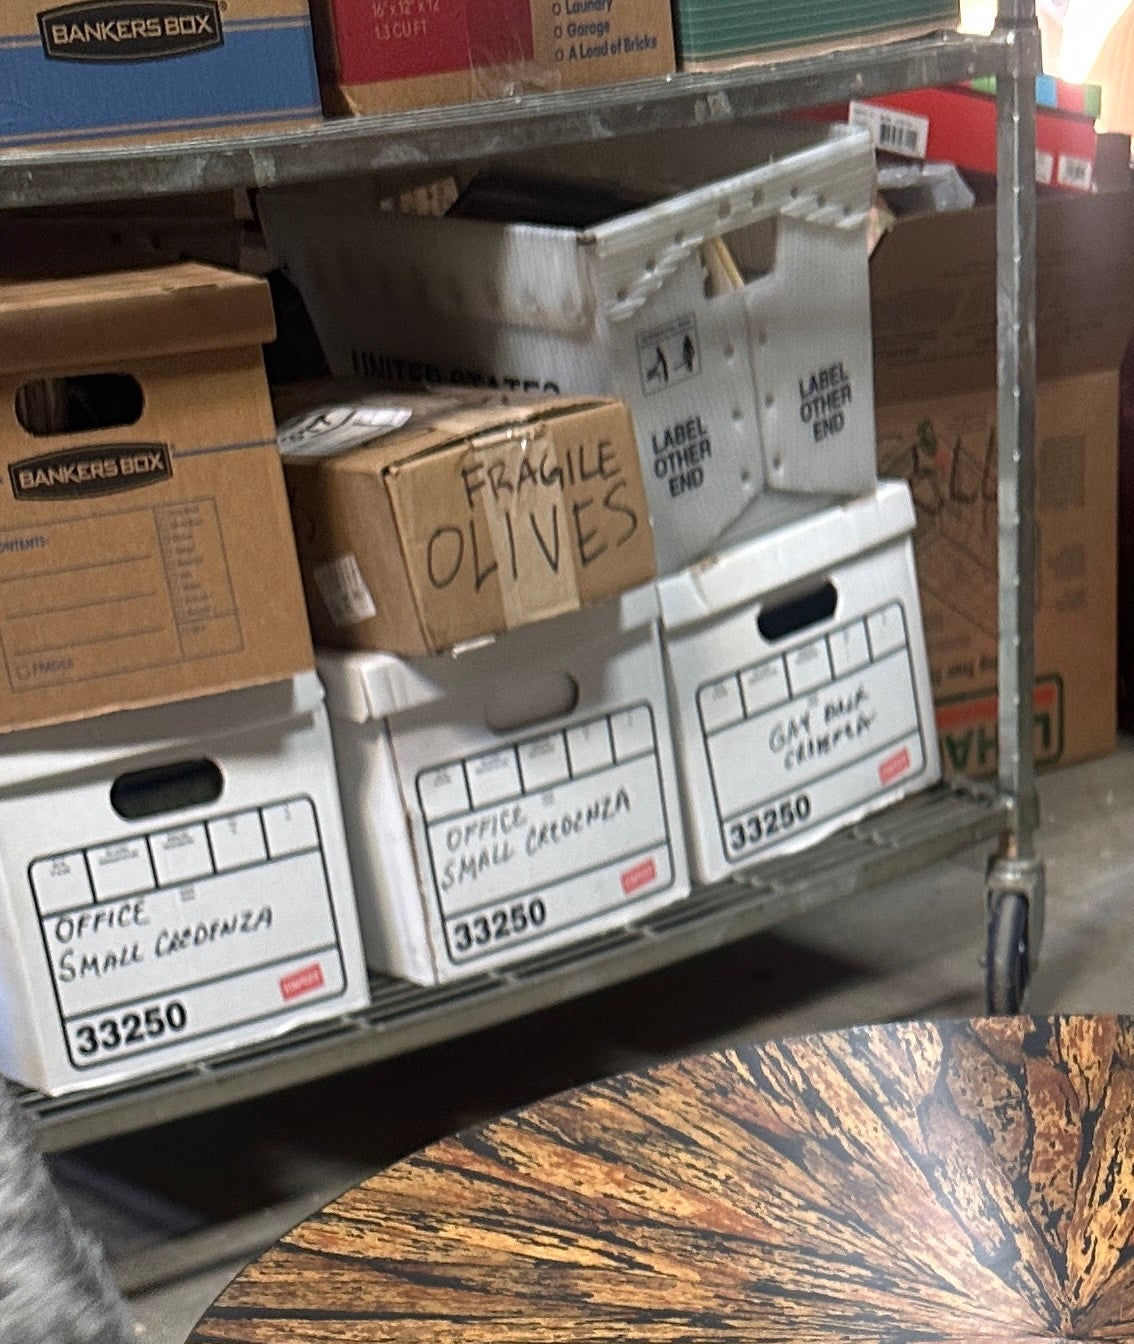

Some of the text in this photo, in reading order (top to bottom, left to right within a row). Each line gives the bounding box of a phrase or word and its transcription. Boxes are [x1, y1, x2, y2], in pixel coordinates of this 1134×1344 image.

[52, 14, 214, 45] BANKERS BOX
[567, 21, 610, 38] Garage
[569, 34, 658, 61] A Load of Bricks
[799, 361, 849, 400] LABEL
[800, 382, 852, 424] OTHER
[652, 415, 709, 455] LABEL
[812, 411, 845, 443] END
[18, 452, 164, 489] BANKERS BOX
[461, 438, 622, 511] FRAGILE
[654, 438, 712, 479] OTHER
[668, 466, 704, 498] END
[426, 477, 639, 593] OLIVES
[441, 786, 632, 891] SMALL CREDENZA
[446, 804, 528, 852] OFFICE
[729, 793, 811, 850] 33250
[55, 900, 151, 944] OFFICE
[453, 896, 546, 951] 33250
[58, 904, 274, 983] SMALL CREDENZA
[75, 999, 188, 1056] 33250
